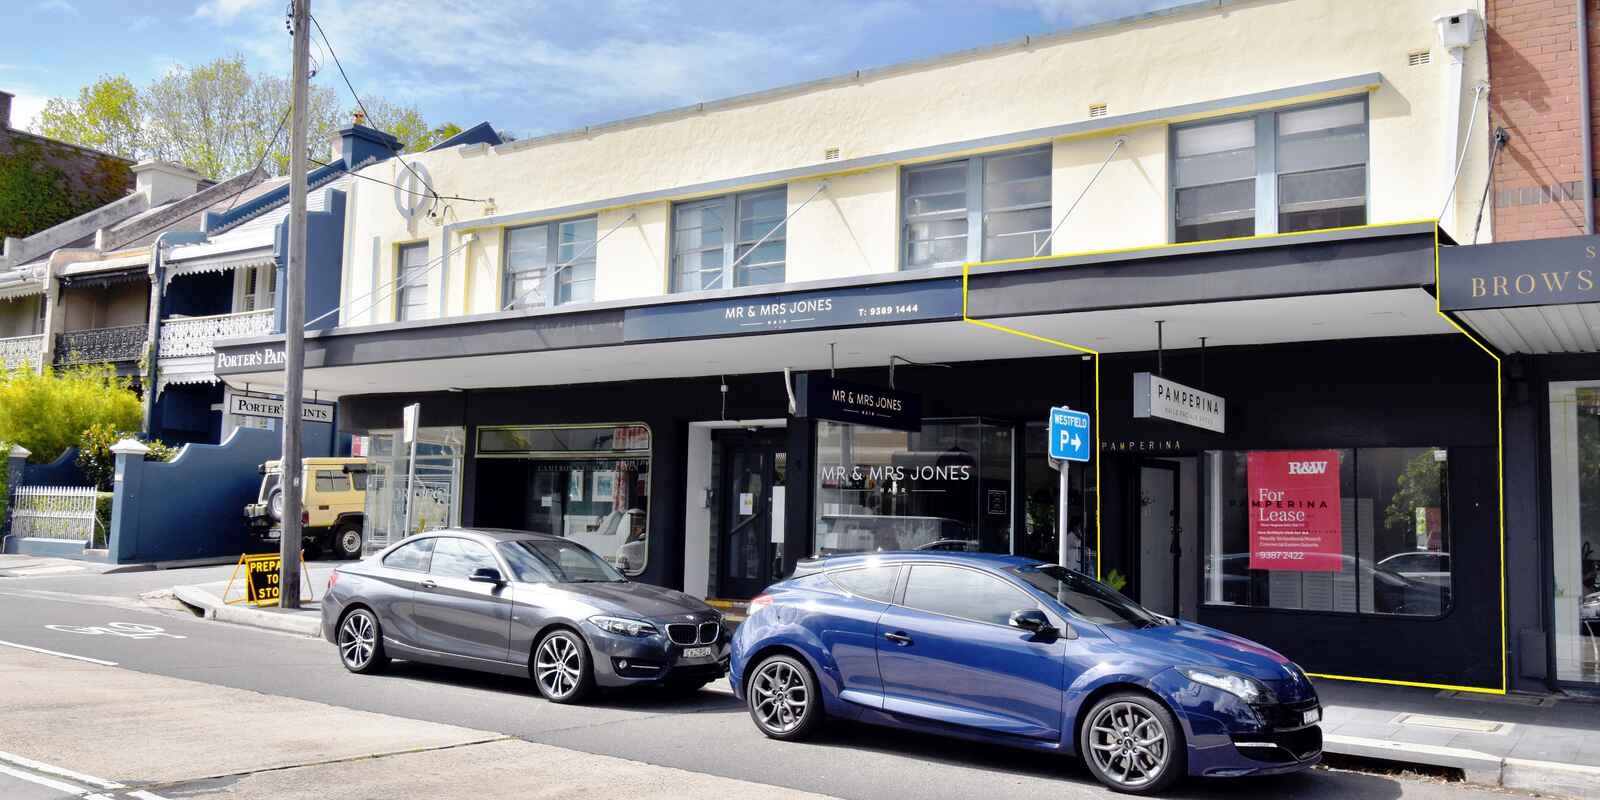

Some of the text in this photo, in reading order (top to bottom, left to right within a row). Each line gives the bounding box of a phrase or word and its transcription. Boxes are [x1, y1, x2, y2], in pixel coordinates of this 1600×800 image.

[725, 298, 833, 319] MR & MRS JONES
[895, 303, 919, 314] 1444
[263, 348, 287, 364] PAIN
[832, 389, 902, 411] MR & MRS JONES
[1158, 384, 1219, 414] PAMPERINA
[238, 399, 328, 419] PORTER' INTS
[1054, 414, 1088, 429] WESTFIELD
[1060, 429, 1070, 451] P
[1101, 439, 1181, 450] PAMPERINA
[821, 465, 970, 481] MR & MRS JONES
[1287, 461, 1328, 475] R&W
[1259, 488, 1285, 502] For
[1260, 507, 1305, 522] Lease
[250, 560, 281, 573] PREPA
[266, 574, 279, 585] TO
[258, 586, 279, 598] STO
